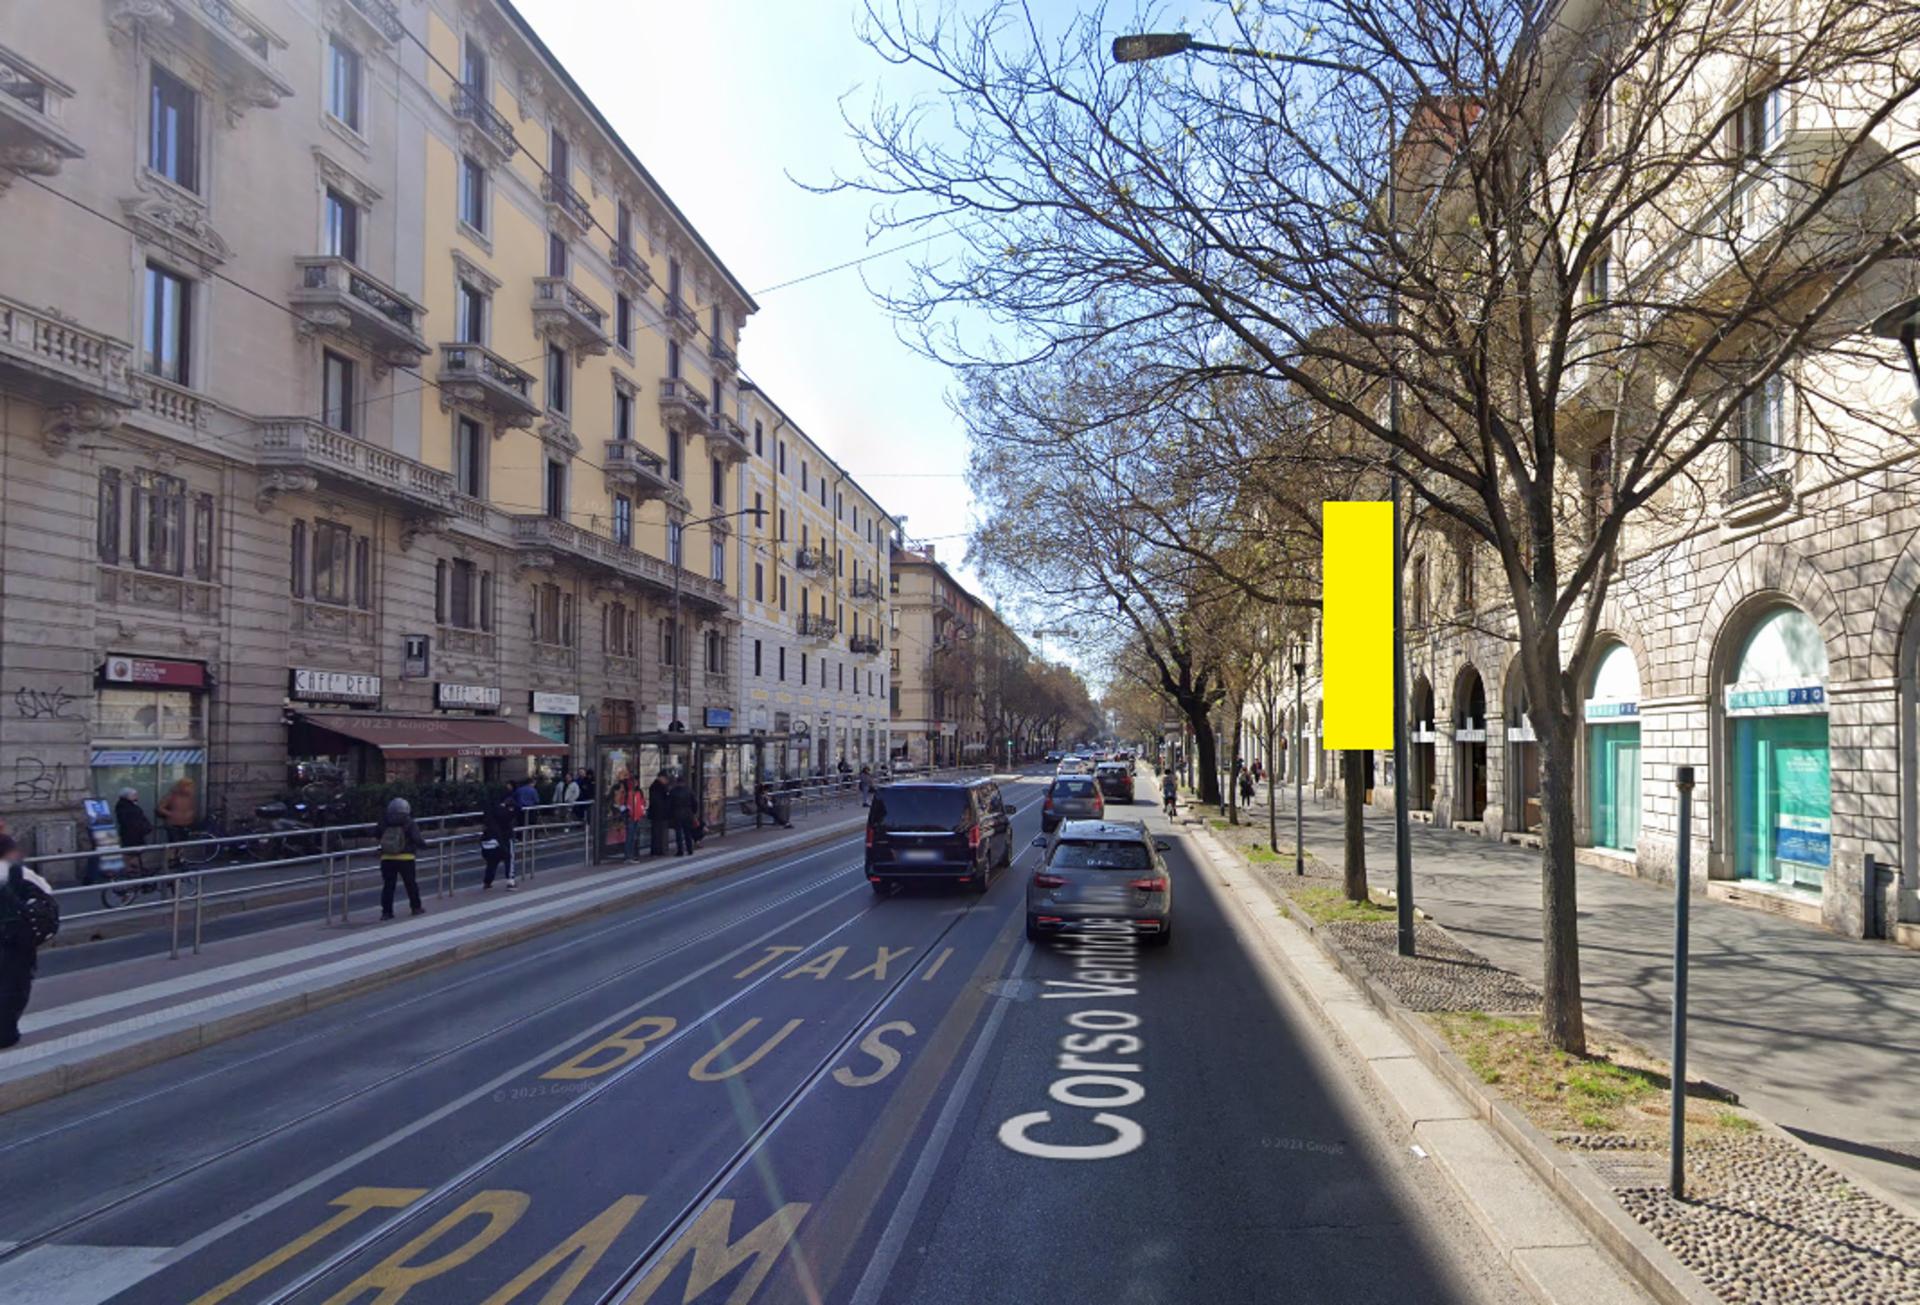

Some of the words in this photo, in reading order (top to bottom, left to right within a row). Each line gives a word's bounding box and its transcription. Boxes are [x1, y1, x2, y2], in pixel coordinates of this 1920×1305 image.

[733, 945, 955, 982] TAXI
[539, 1016, 916, 1088] BUS
[193, 1186, 812, 1305] TRAM
